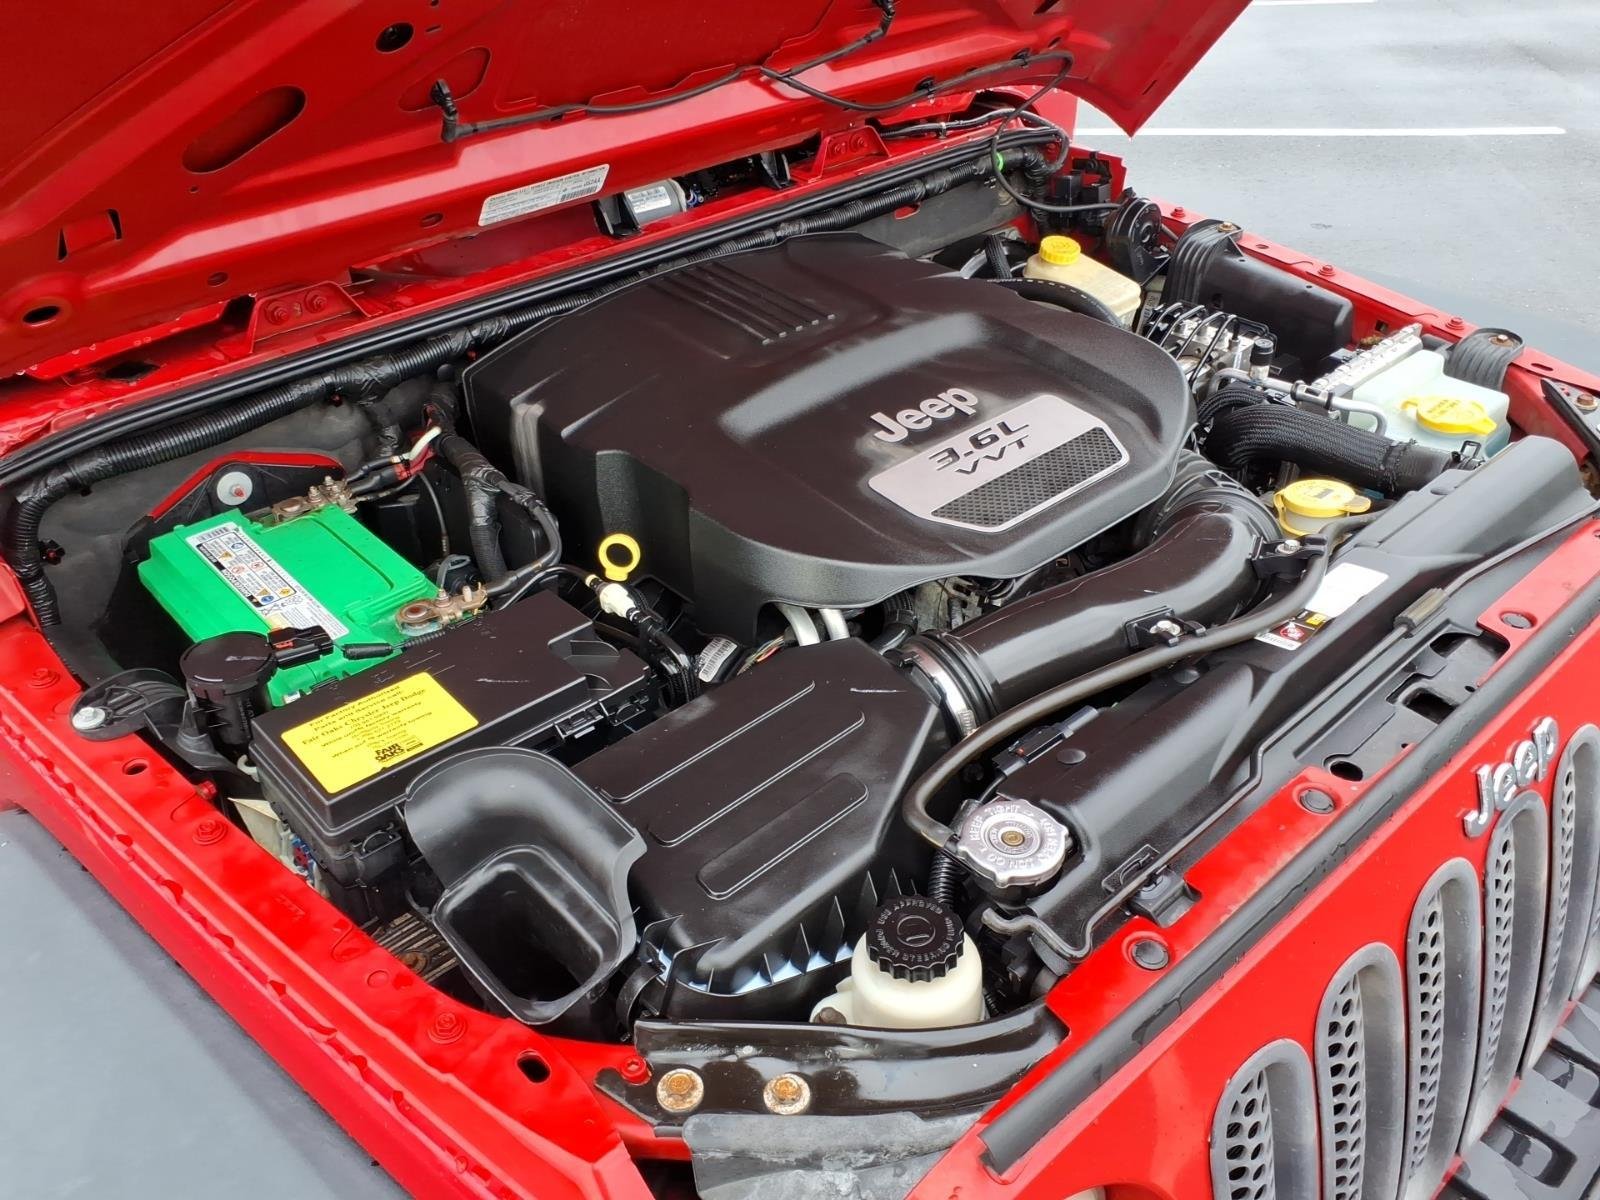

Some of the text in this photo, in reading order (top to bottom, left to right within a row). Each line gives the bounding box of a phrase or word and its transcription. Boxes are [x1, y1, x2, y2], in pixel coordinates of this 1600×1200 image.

[870, 387, 978, 443] Jeep
[928, 421, 1030, 471] 3.6L
[955, 434, 1029, 475] VVT
[302, 735, 319, 745] Fair
[321, 725, 343, 736] Oaks
[344, 709, 379, 726] Chrysler
[382, 699, 400, 710] Jeep
[400, 689, 426, 702] Dodge
[375, 743, 402, 756] FAIR
[375, 748, 405, 762] OAKS
[1463, 716, 1559, 837] Jeep
